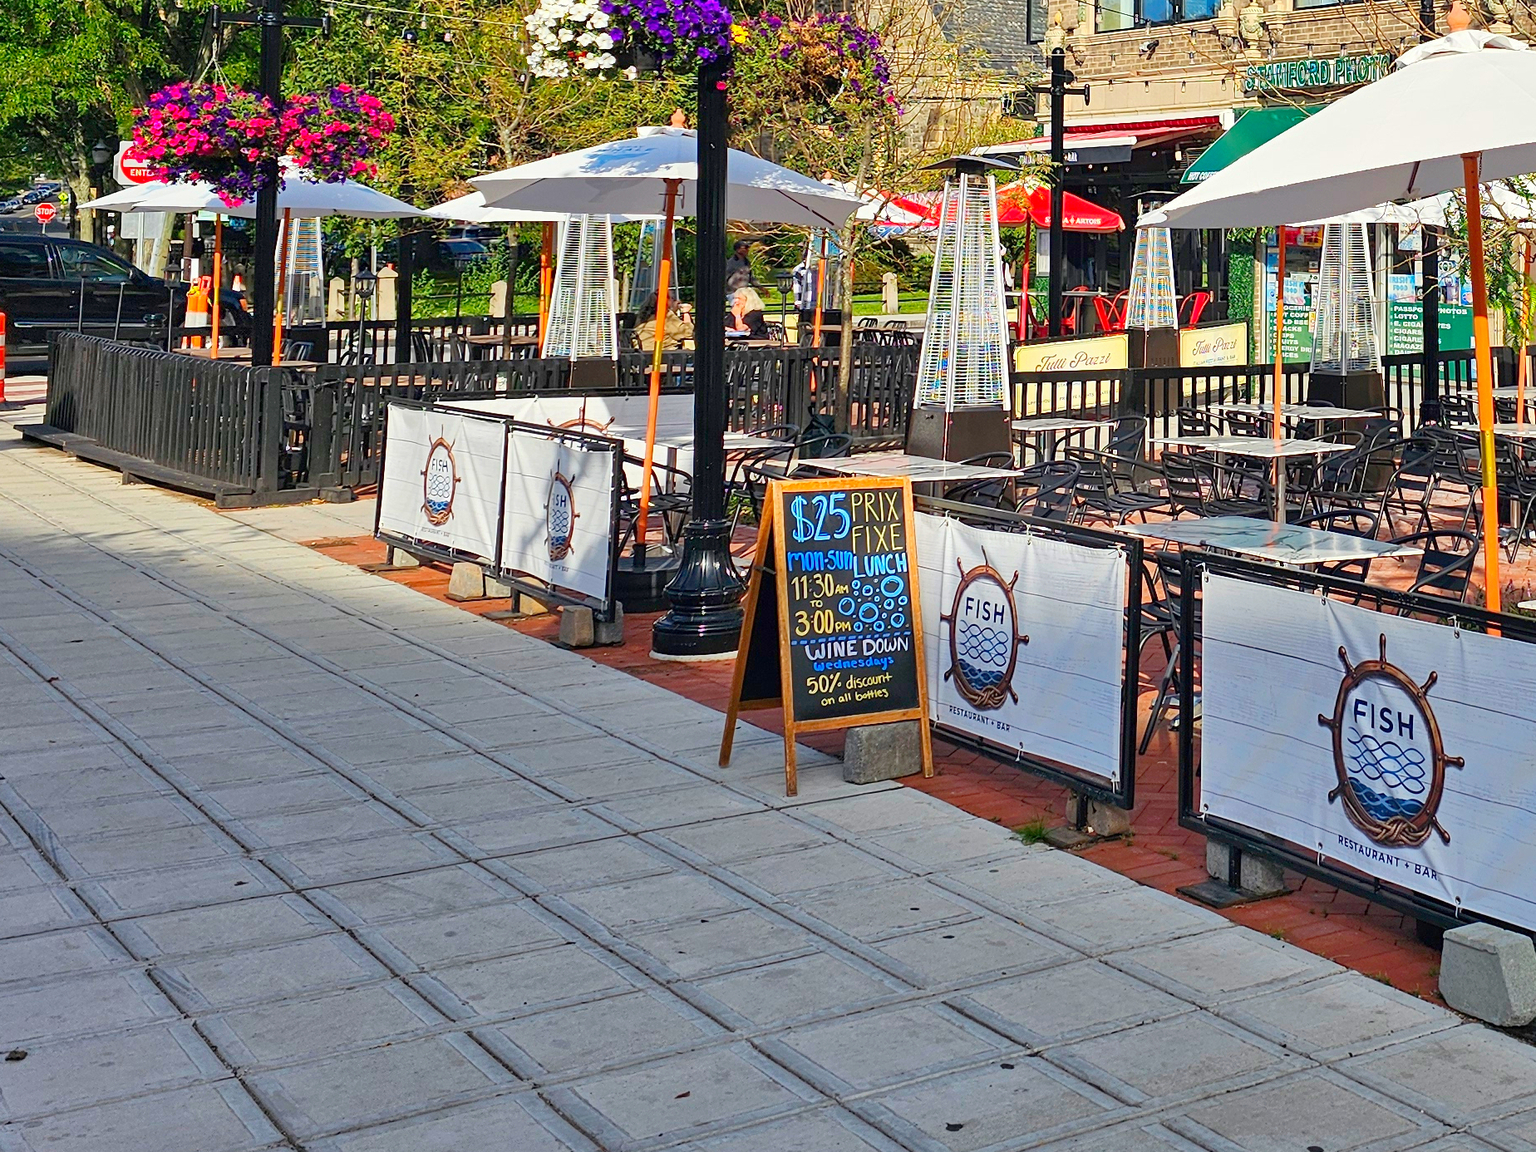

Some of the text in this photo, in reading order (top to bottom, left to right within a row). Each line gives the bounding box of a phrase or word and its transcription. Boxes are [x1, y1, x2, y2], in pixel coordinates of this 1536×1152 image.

[1245, 59, 1330, 91] STAMFORD
[36, 207, 55, 216] STOP
[1069, 351, 1111, 369] Pazzi
[432, 458, 449, 473] FISH
[790, 492, 851, 542] $25
[851, 491, 899, 523] PRIX
[852, 522, 903, 554] FIXE
[853, 552, 908, 578] LUNCH
[965, 596, 1005, 625] FISH
[804, 636, 909, 661] WINE DOWN
[806, 672, 893, 694] 50% discount
[821, 688, 889, 707] on all bottles
[949, 705, 991, 726] RESTAURANT
[996, 720, 1011, 733] BAR
[1353, 698, 1414, 740] FISH
[1338, 834, 1400, 867] RESTAURANT
[1414, 863, 1437, 881] BAR
